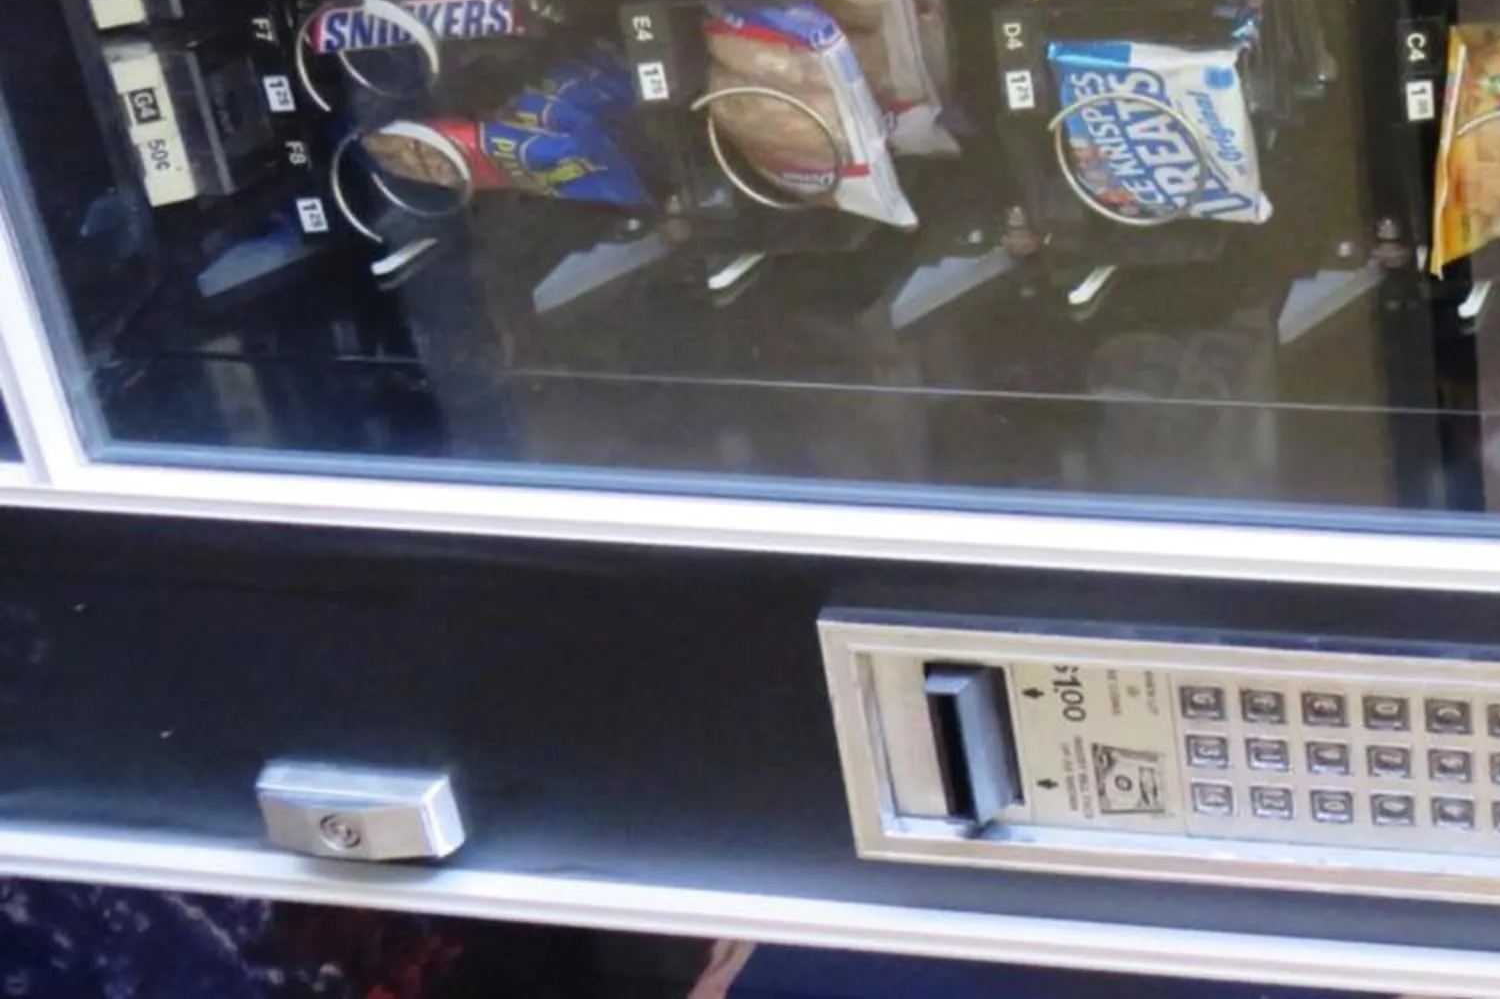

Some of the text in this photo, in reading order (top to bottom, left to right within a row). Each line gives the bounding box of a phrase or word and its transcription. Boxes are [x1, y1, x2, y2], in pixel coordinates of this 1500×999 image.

[252, 17, 273, 42] F7
[324, 0, 515, 53] SNIKERS
[632, 16, 653, 42] E4
[1004, 22, 1025, 50] D4
[1406, 32, 1428, 62] C4
[133, 91, 155, 120] G4
[1070, 70, 1146, 176] KRISPES
[1185, 89, 1244, 163] Original
[285, 140, 307, 166] F8
